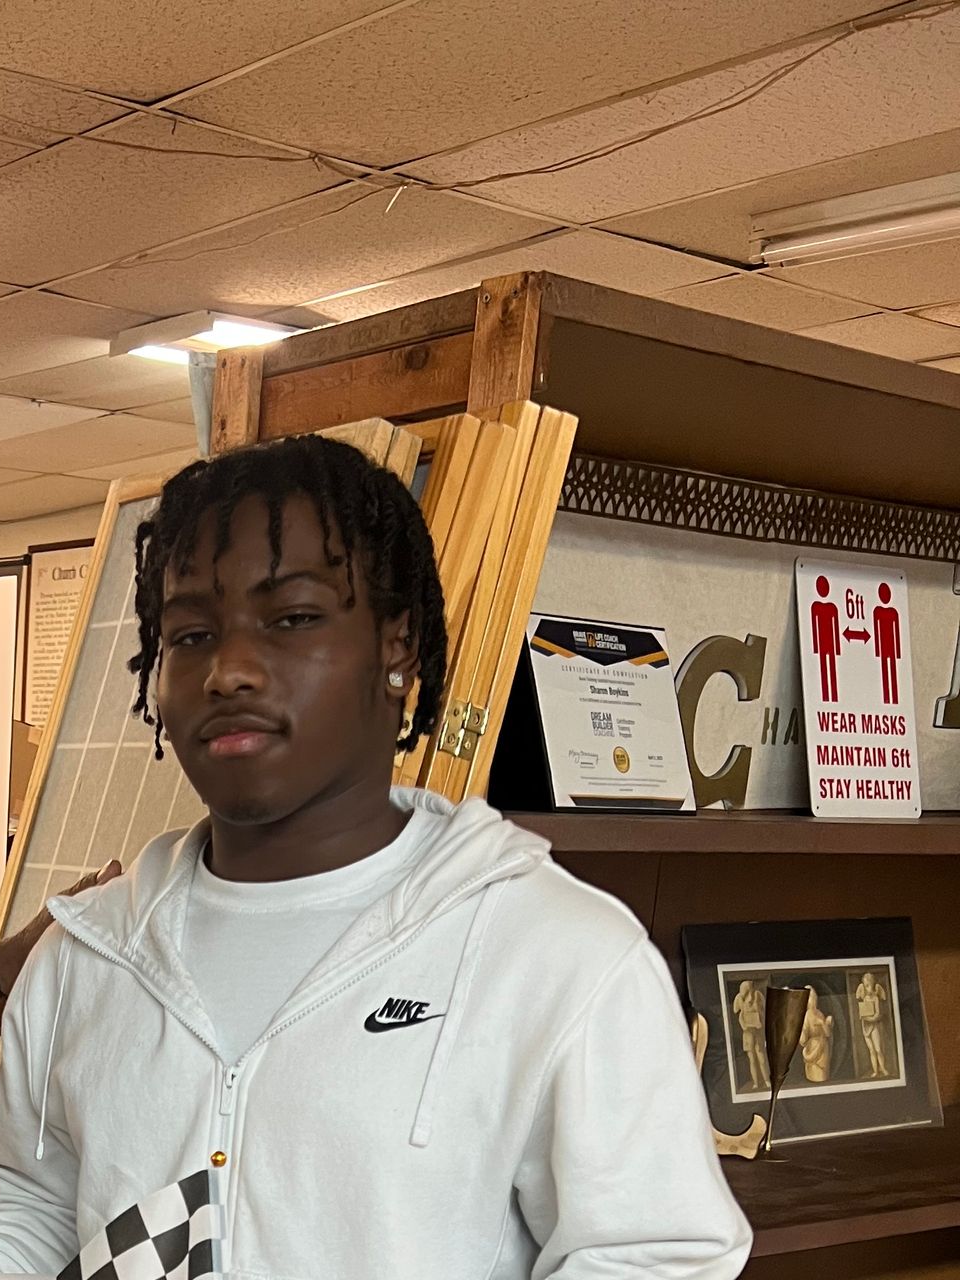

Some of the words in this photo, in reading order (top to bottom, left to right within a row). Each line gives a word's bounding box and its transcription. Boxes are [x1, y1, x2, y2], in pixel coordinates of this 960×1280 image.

[845, 588, 865, 620] 6ft
[590, 711, 612, 721] DREAM
[817, 711, 856, 734] WEAR
[861, 713, 907, 736] MASKS
[816, 744, 887, 767] MAINTAIN
[891, 748, 912, 769] 6ft
[819, 778, 852, 799] STAY
[855, 779, 912, 801] HEALTHY
[377, 996, 431, 1021] NIKE
